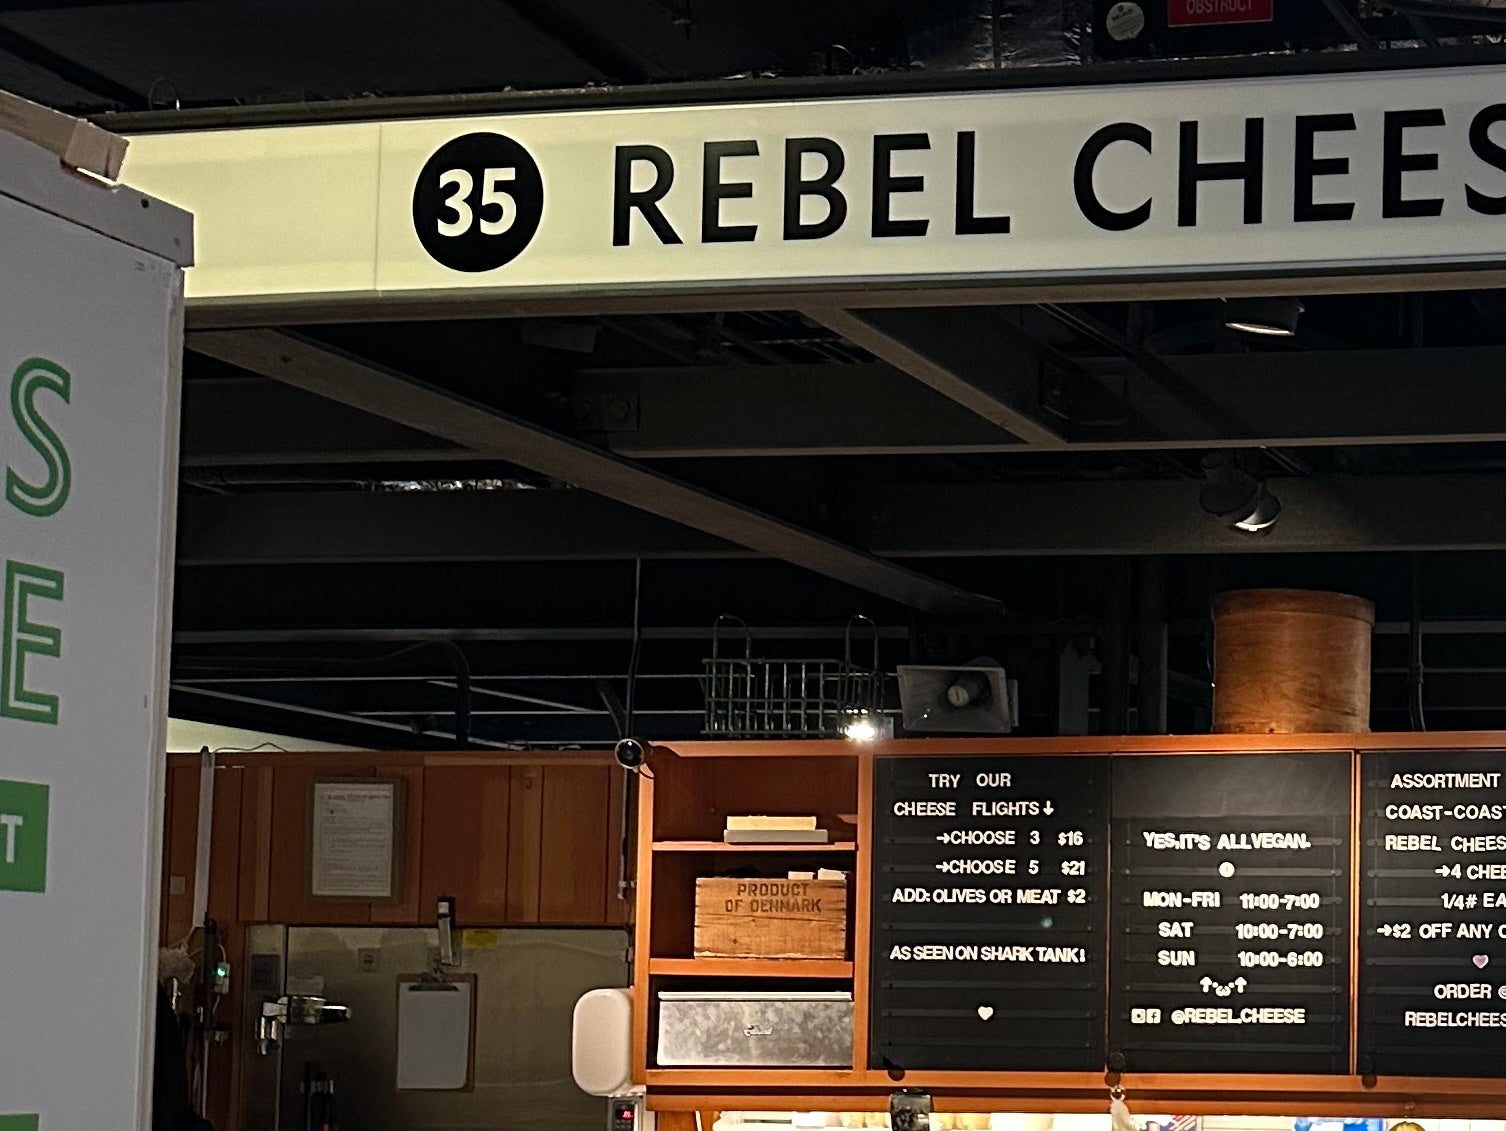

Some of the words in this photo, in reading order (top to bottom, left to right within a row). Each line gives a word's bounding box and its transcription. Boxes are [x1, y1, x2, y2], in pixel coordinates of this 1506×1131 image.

[436, 169, 517, 237] 35
[612, 130, 1012, 247] REBEL
[928, 772, 961, 789] TRY
[976, 772, 1011, 788] OUR
[1390, 773, 1502, 789] ASSORTMENT
[893, 801, 956, 817] CHEESE
[972, 801, 1040, 817] FLIGHTS
[950, 830, 1016, 845] CHOOSE
[1029, 830, 1041, 845] 3
[1057, 831, 1084, 847] $16
[1385, 835, 1442, 852] REBEL
[949, 859, 1016, 875] CHOOSE
[1028, 859, 1040, 876] 5
[1061, 860, 1086, 877] $21
[737, 882, 810, 897] PRODUCT
[932, 888, 987, 904] OLIVES
[989, 888, 1013, 904] OR
[1016, 889, 1061, 905] MEAT
[1067, 889, 1087, 905] $2
[725, 899, 744, 913] OF
[750, 899, 822, 913] DENMARK
[1143, 891, 1221, 909] MON-FRI
[1158, 922, 1194, 939] SAT
[1235, 923, 1324, 941] 10:00-7:00
[1419, 923, 1453, 939] OFF
[1456, 924, 1493, 939] ANY
[890, 946, 913, 962] AS
[913, 946, 955, 962] SEEN
[955, 946, 978, 961] ON
[980, 946, 1034, 962] SHARK
[1036, 947, 1086, 964] TANK!
[1157, 950, 1196, 967] SUN
[1238, 950, 1324, 968] 10:00-6:00
[1433, 984, 1492, 999] ORDER
